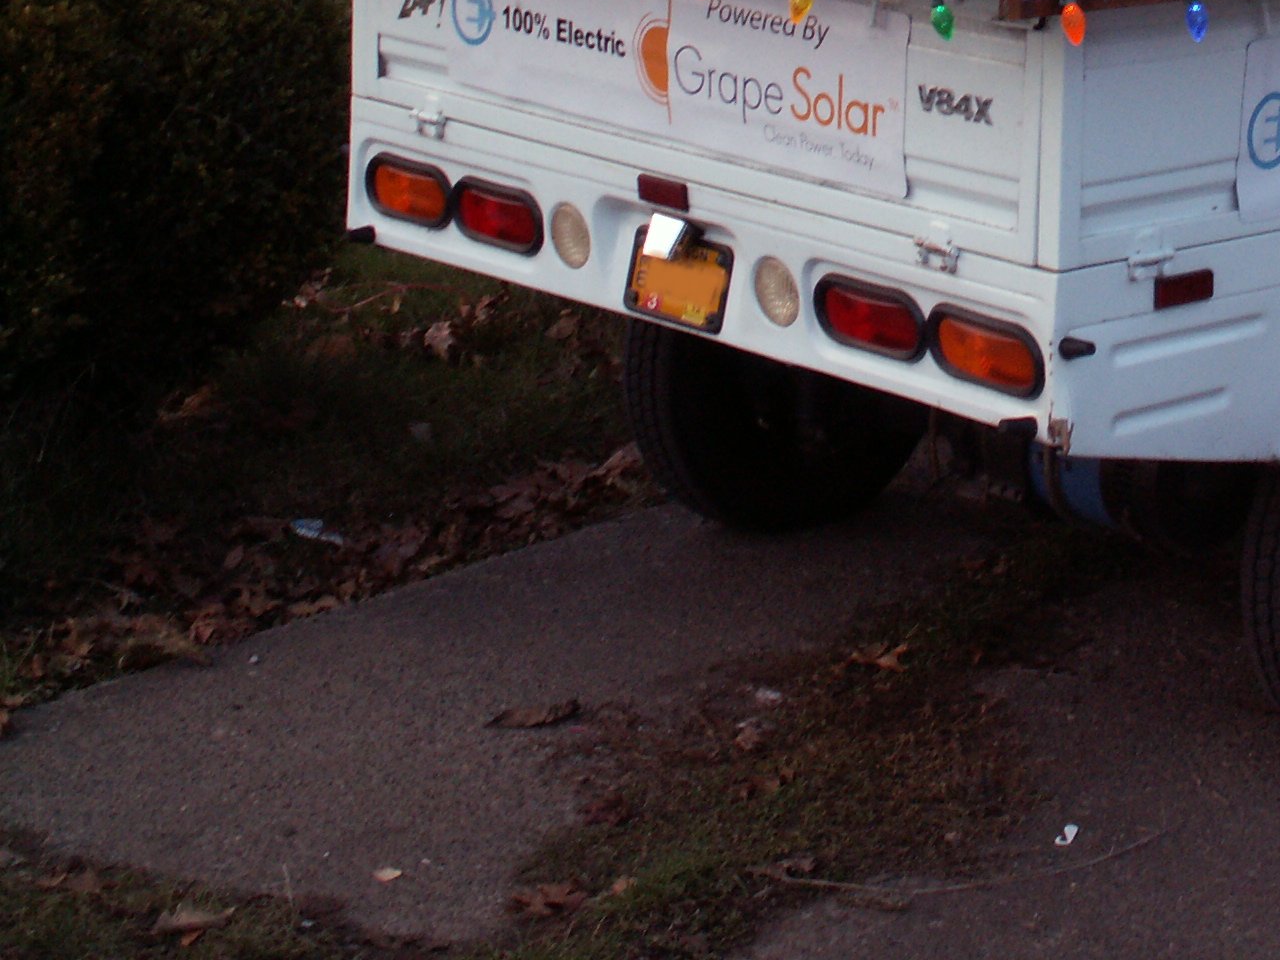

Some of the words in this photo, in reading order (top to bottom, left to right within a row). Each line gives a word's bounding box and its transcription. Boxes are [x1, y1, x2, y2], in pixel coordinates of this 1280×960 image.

[502, 5, 550, 40] 100%
[556, 18, 626, 58] Electric
[802, 15, 830, 50] By
[674, 45, 784, 124] Grape
[790, 66, 886, 138] Solar
[763, 124, 798, 144] Clean
[799, 131, 834, 157] Power
[839, 141, 875, 171] Today
